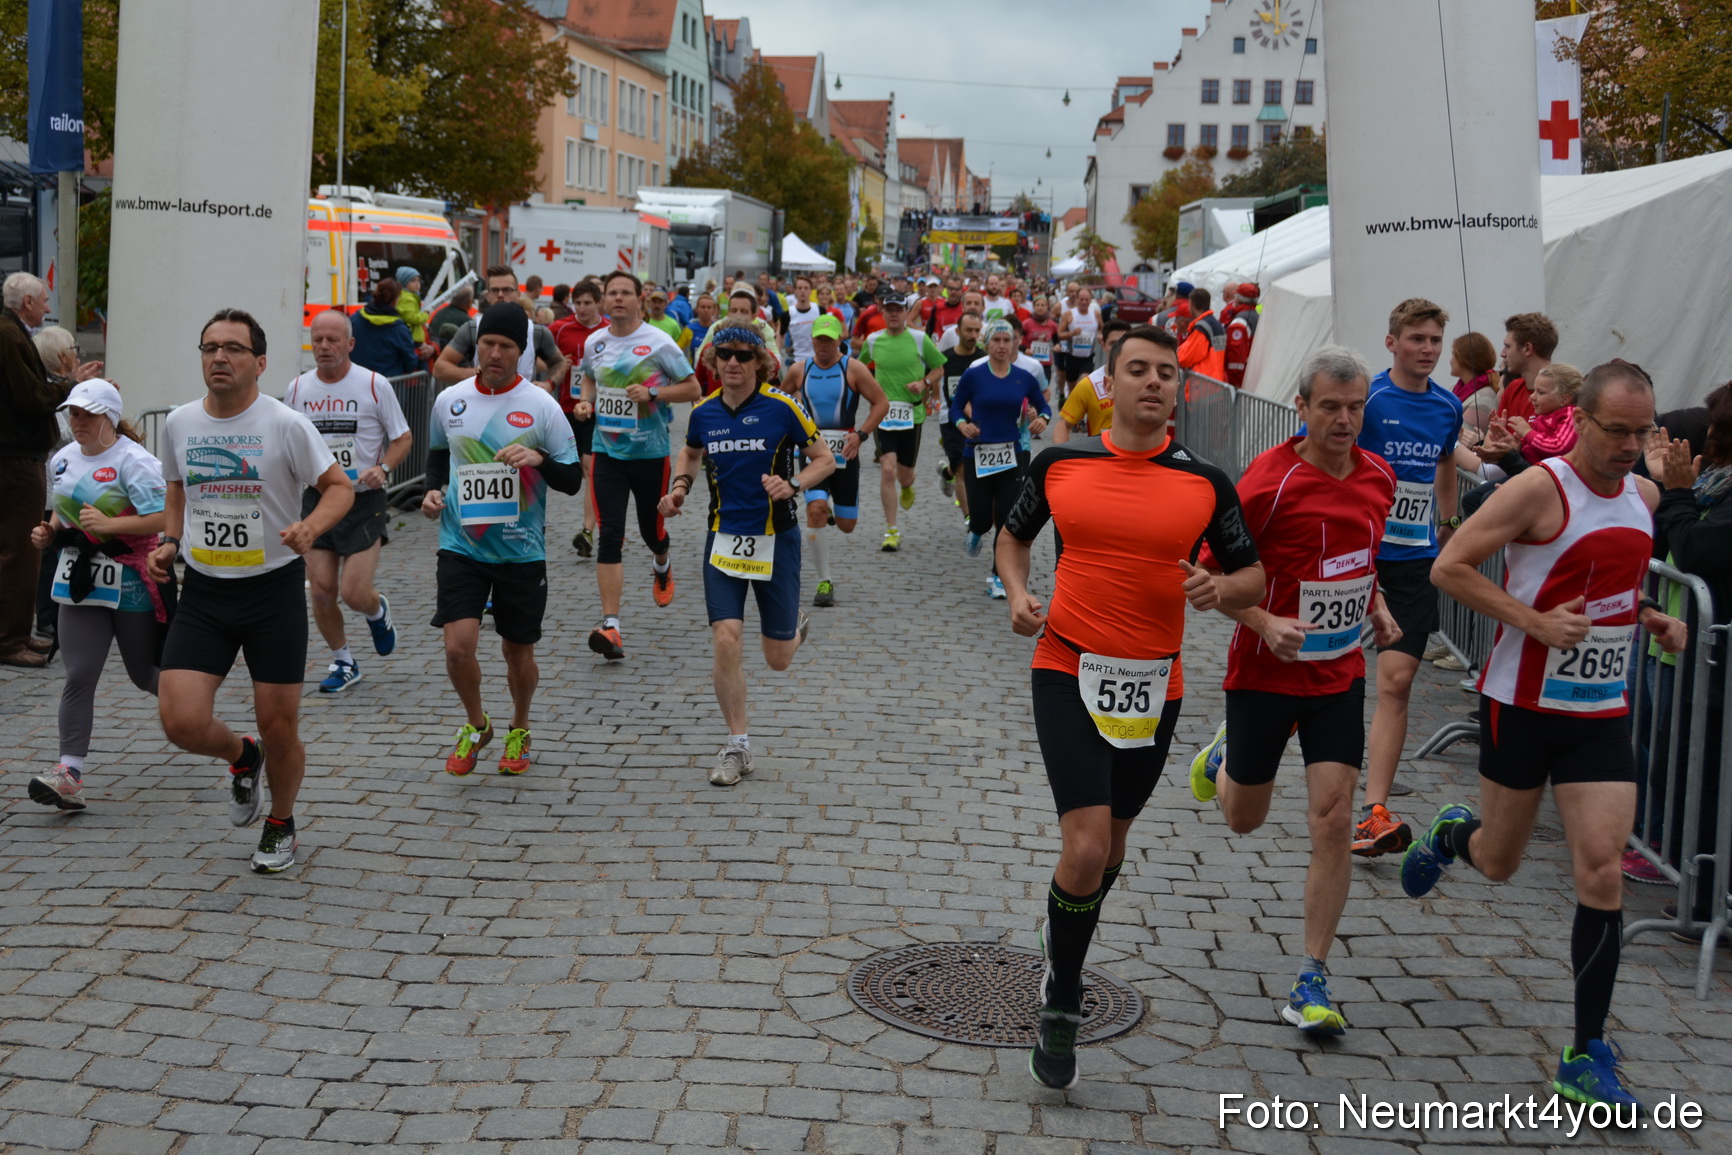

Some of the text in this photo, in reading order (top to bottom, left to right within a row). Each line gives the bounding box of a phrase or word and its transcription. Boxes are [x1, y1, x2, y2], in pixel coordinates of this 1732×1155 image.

[115, 196, 273, 219] www.bmw-laufsport.de
[1365, 213, 1538, 235] www.bmw-laufsport.de
[598, 397, 634, 416] 2082
[708, 428, 730, 437] TEAM
[187, 436, 262, 445] BLACKMORES
[707, 439, 767, 454] BOCK
[237, 449, 263, 457] 2013
[1383, 441, 1441, 458] SYSCAD
[980, 450, 1012, 466] 2242
[199, 484, 262, 493] FINISHER
[463, 477, 514, 501] 3040
[192, 508, 249, 519] PARTL Neumarkt
[204, 521, 249, 548] 526
[1390, 524, 1414, 537] Niklas
[732, 535, 756, 557] 23
[717, 558, 765, 572] Franz Xaver
[1336, 557, 1356, 569] DEHN
[62, 559, 116, 586] 370
[1302, 585, 1365, 597] PARTL Neumarkt
[1310, 595, 1366, 629] 2398
[1600, 600, 1622, 612] DEHN
[1328, 634, 1349, 648] Ernst
[1591, 634, 1626, 643] Neumarkt
[1081, 661, 1157, 677] PARTL Neumarkt
[1557, 646, 1626, 679] 2695
[1097, 679, 1151, 713] 535
[1571, 687, 1608, 699] Rainer
